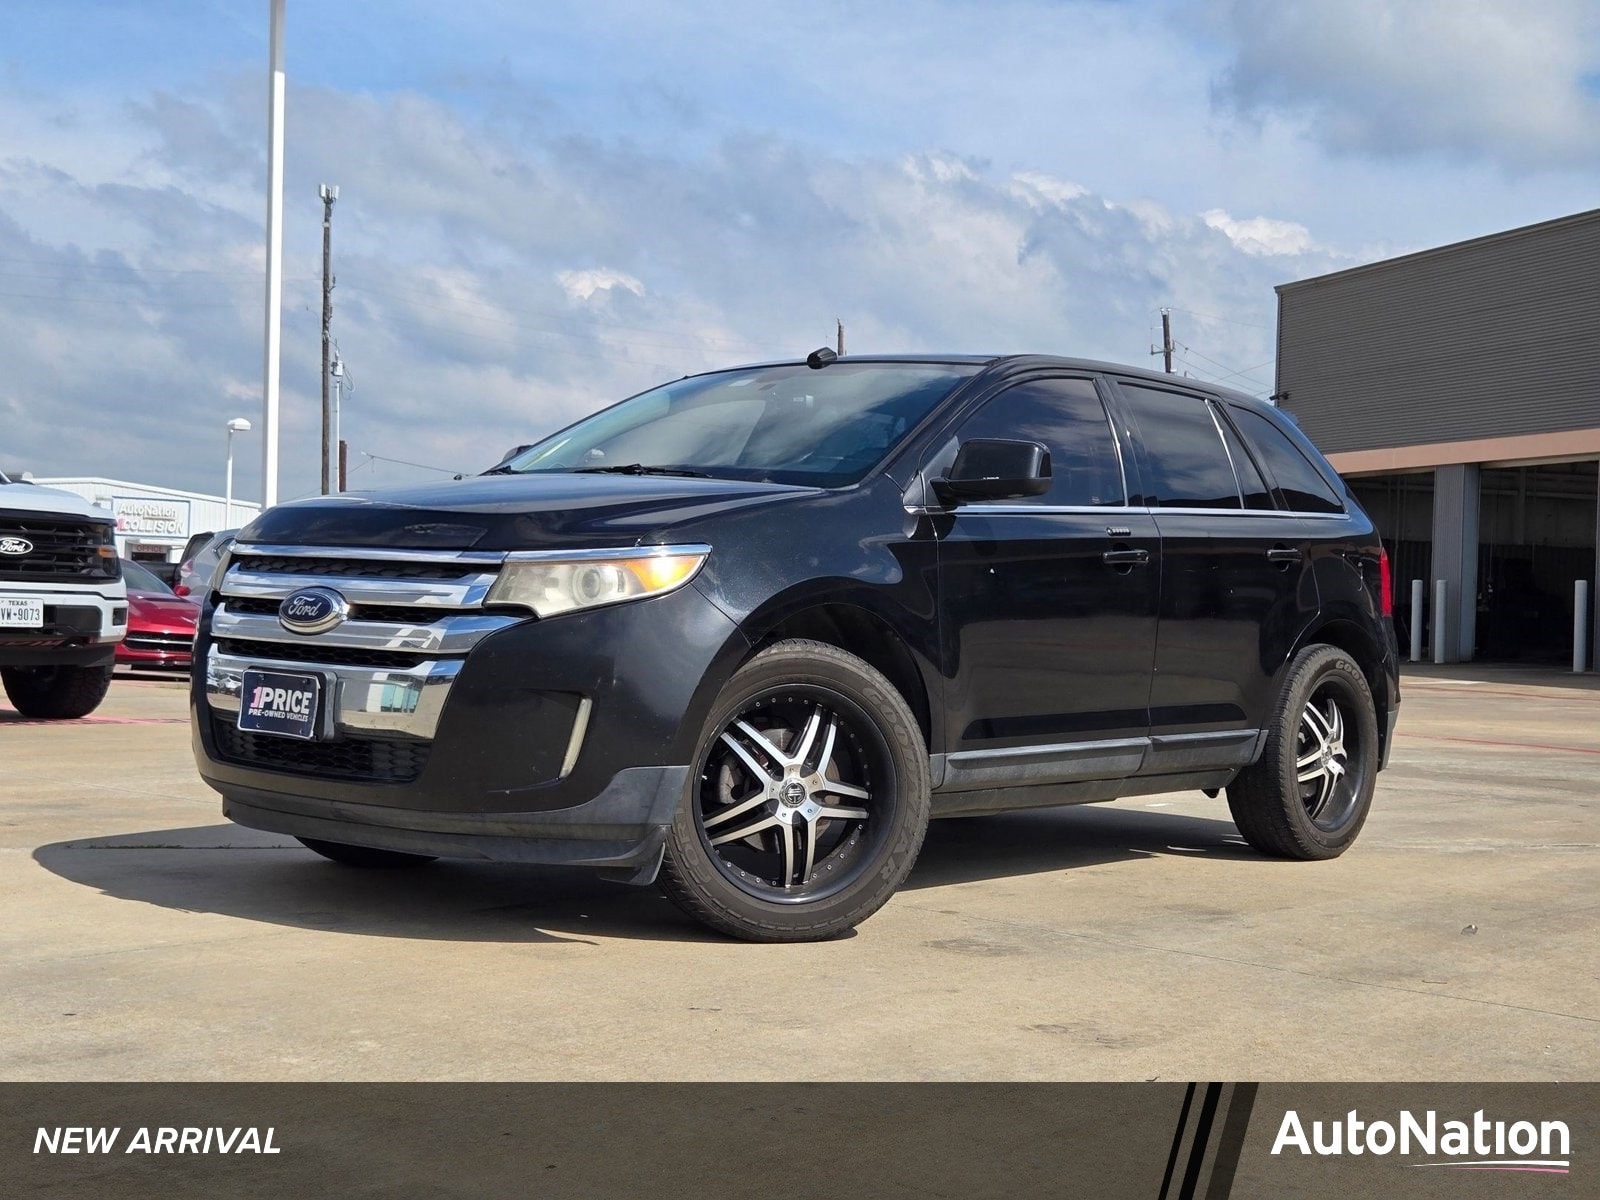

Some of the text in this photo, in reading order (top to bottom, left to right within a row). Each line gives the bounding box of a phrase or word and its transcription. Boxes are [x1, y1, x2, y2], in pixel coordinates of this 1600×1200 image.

[118, 502, 176, 518] AutoNation
[1, 540, 25, 551] Ford
[136, 544, 162, 552] OFFICE
[288, 596, 322, 616] Ford
[248, 708, 309, 722] PRE-OWNED VEHICLES
